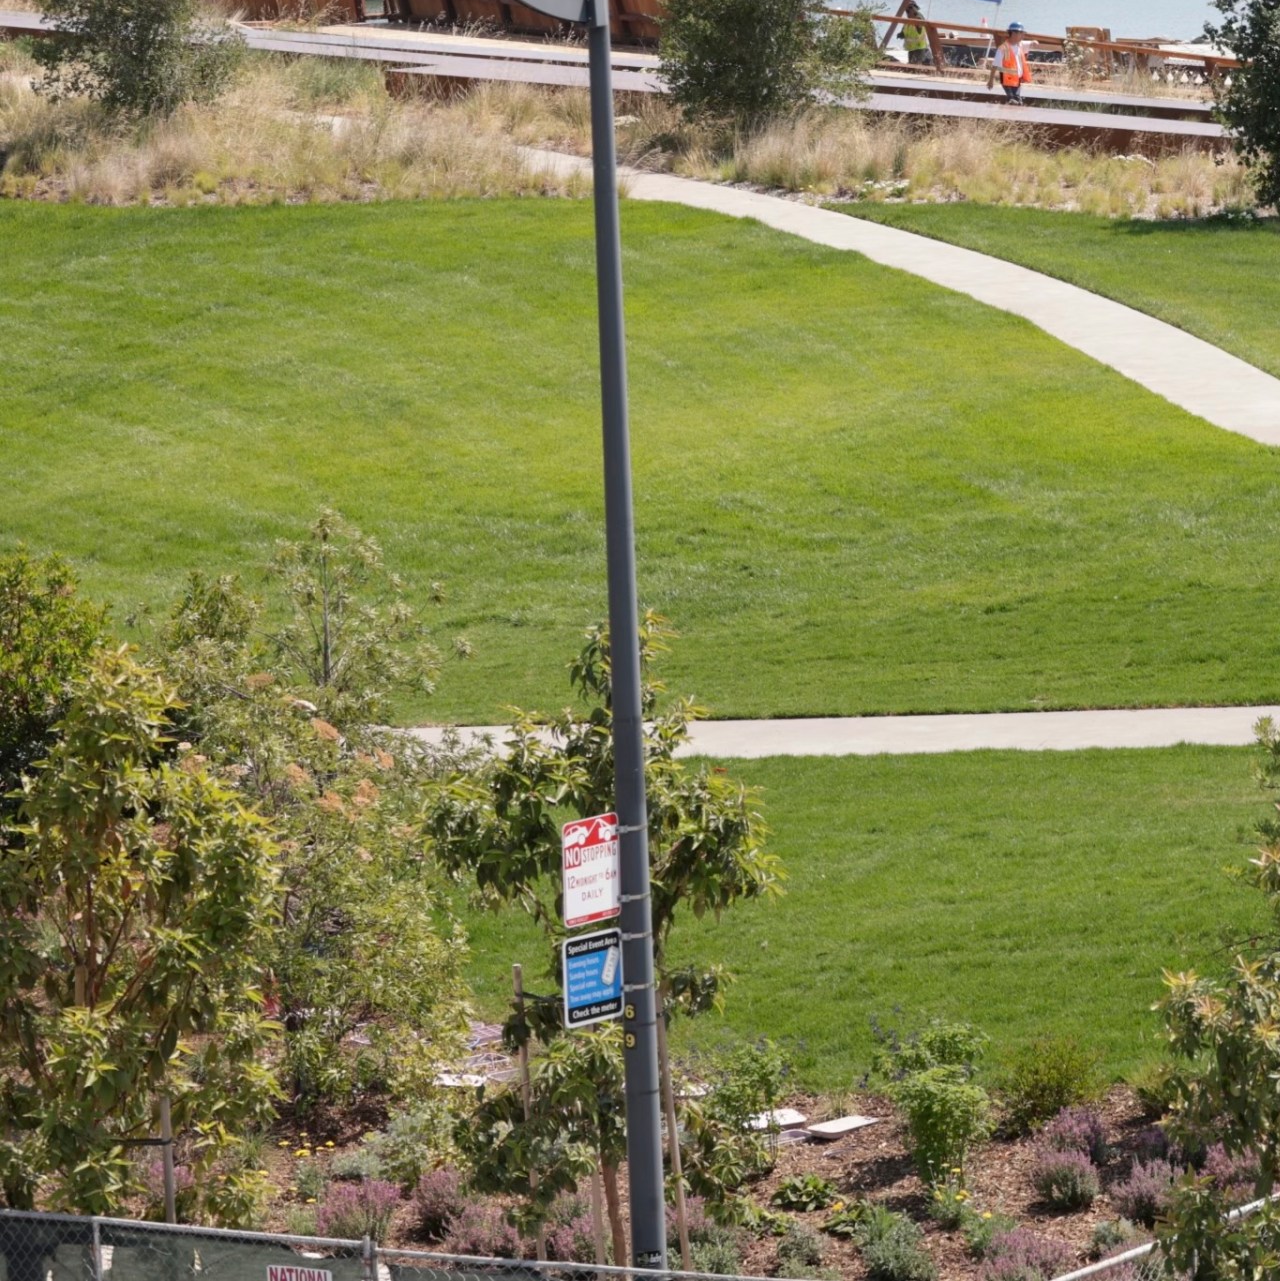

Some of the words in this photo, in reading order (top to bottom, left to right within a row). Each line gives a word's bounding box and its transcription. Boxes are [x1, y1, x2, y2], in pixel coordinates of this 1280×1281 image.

[565, 846, 580, 868] NO
[583, 841, 616, 863] STOPPING
[582, 888, 603, 901] DAILY
[568, 942, 588, 956] Special
[589, 939, 604, 950] Event
[604, 937, 617, 946] Area
[572, 1007, 590, 1019] Check
[590, 1004, 600, 1015] the
[601, 1002, 617, 1012] meter
[625, 1004, 635, 1019] 6
[625, 1033, 636, 1048] 9
